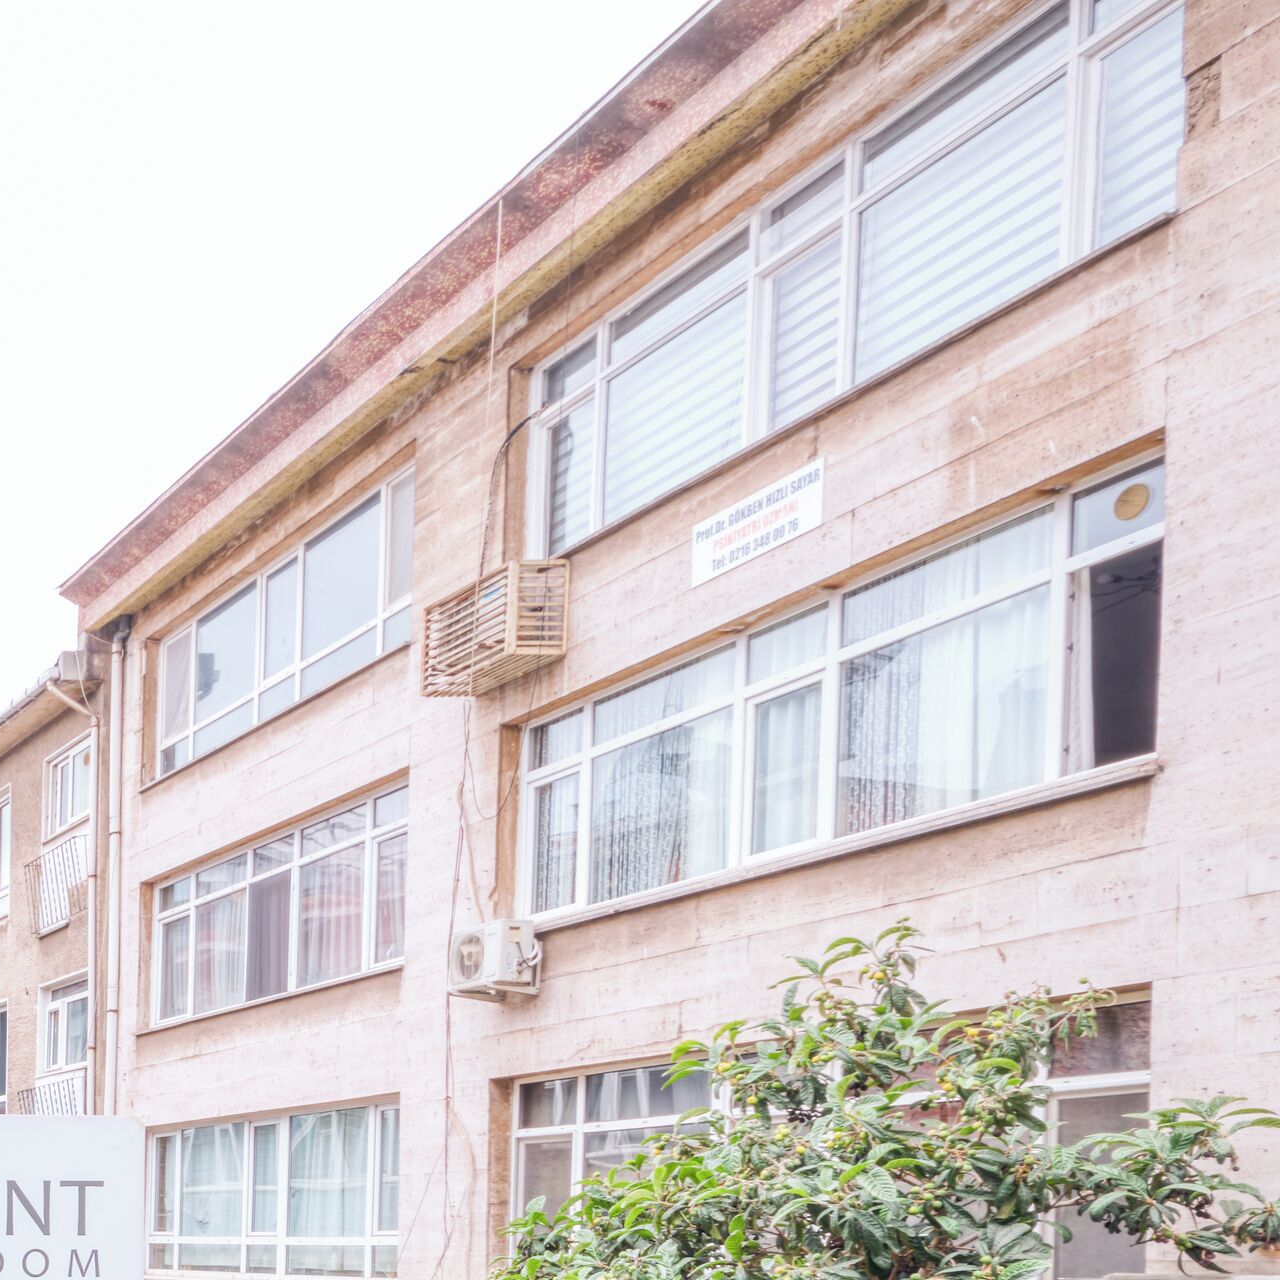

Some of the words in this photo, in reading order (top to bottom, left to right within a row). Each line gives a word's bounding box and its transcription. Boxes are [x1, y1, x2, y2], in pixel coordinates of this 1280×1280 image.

[790, 468, 820, 494] SAYAR
[712, 554, 727, 572] Tel:
[729, 541, 750, 563] 0216
[773, 525, 785, 541] 00
[788, 518, 799, 535] 76
